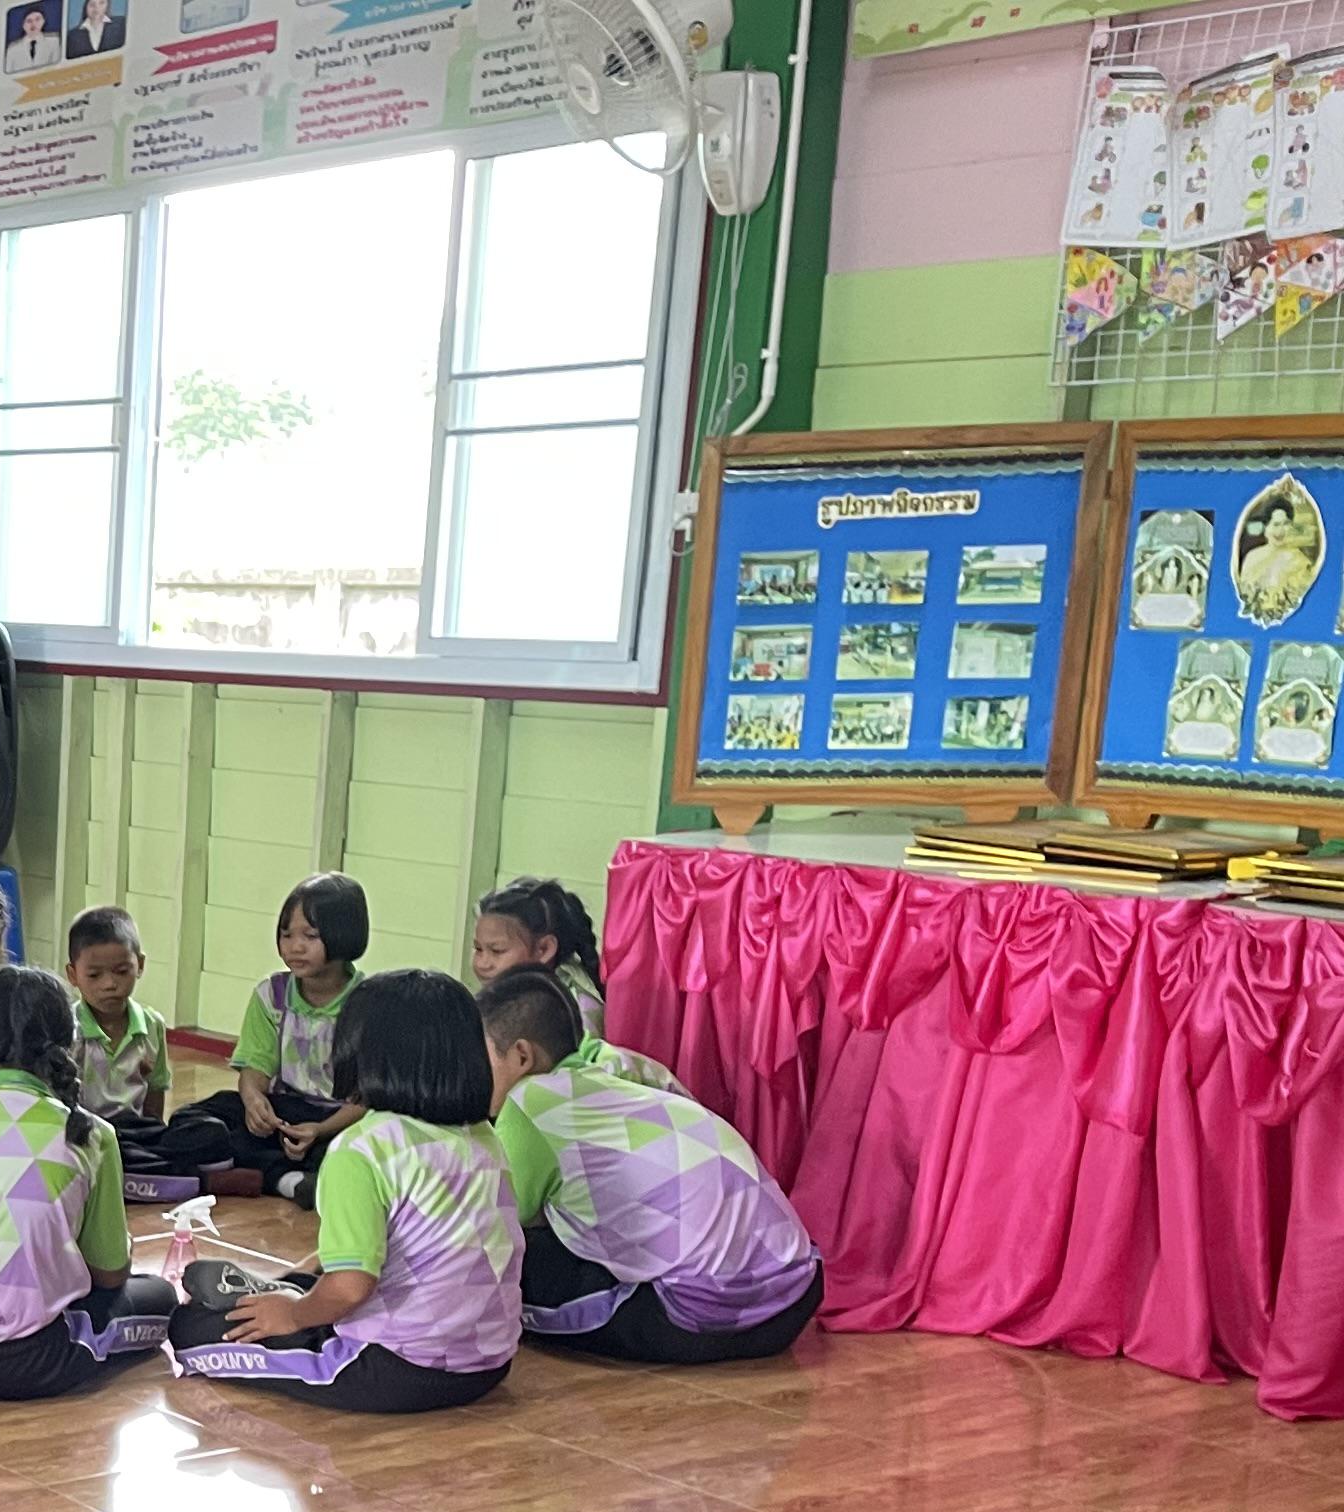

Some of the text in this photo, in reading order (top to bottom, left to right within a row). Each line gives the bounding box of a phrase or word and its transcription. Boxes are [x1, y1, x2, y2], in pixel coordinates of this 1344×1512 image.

[821, 490, 977, 525] รูปภาพกิจกรรม
[125, 1181, 159, 1197] OOL
